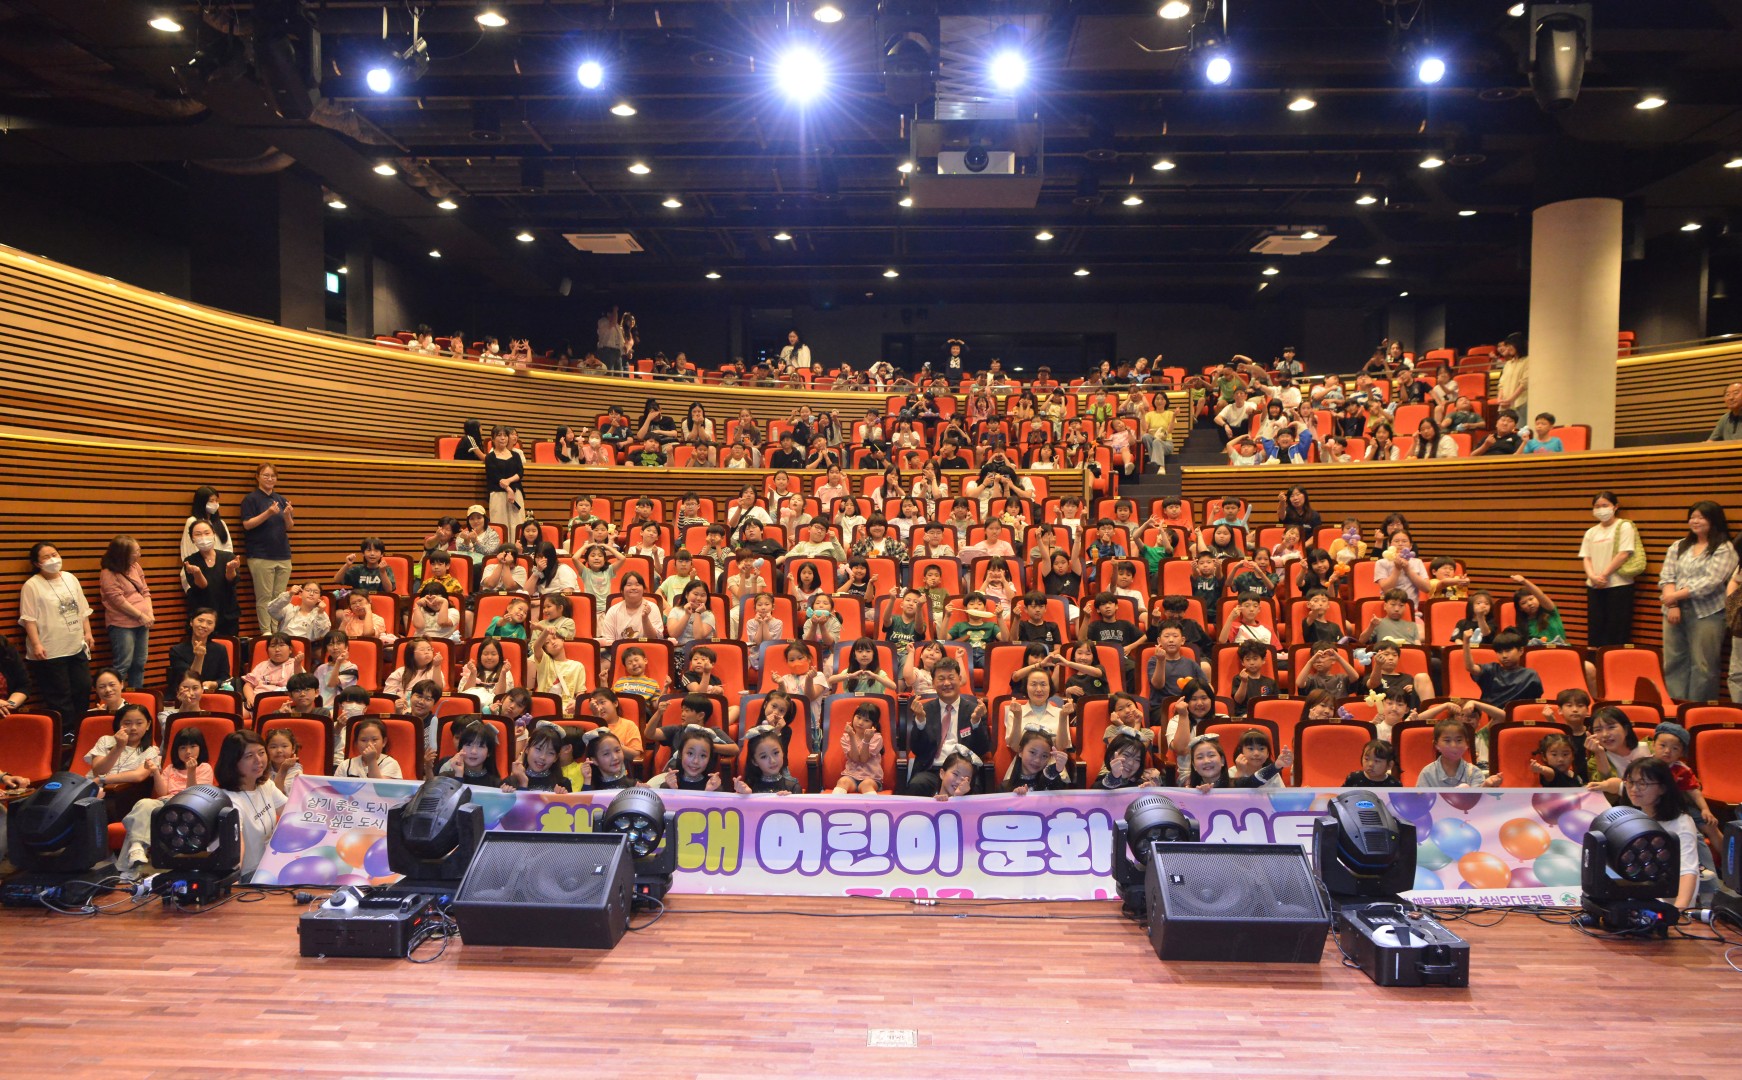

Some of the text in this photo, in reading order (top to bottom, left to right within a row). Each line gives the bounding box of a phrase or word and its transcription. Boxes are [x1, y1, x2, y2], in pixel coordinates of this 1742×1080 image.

[359, 575, 382, 584] FILA
[307, 797, 388, 815] 살기 좋은 도시
[300, 811, 385, 830] 오고 싶은 도시
[756, 809, 963, 877] 어린이
[976, 807, 1113, 877] 문화
